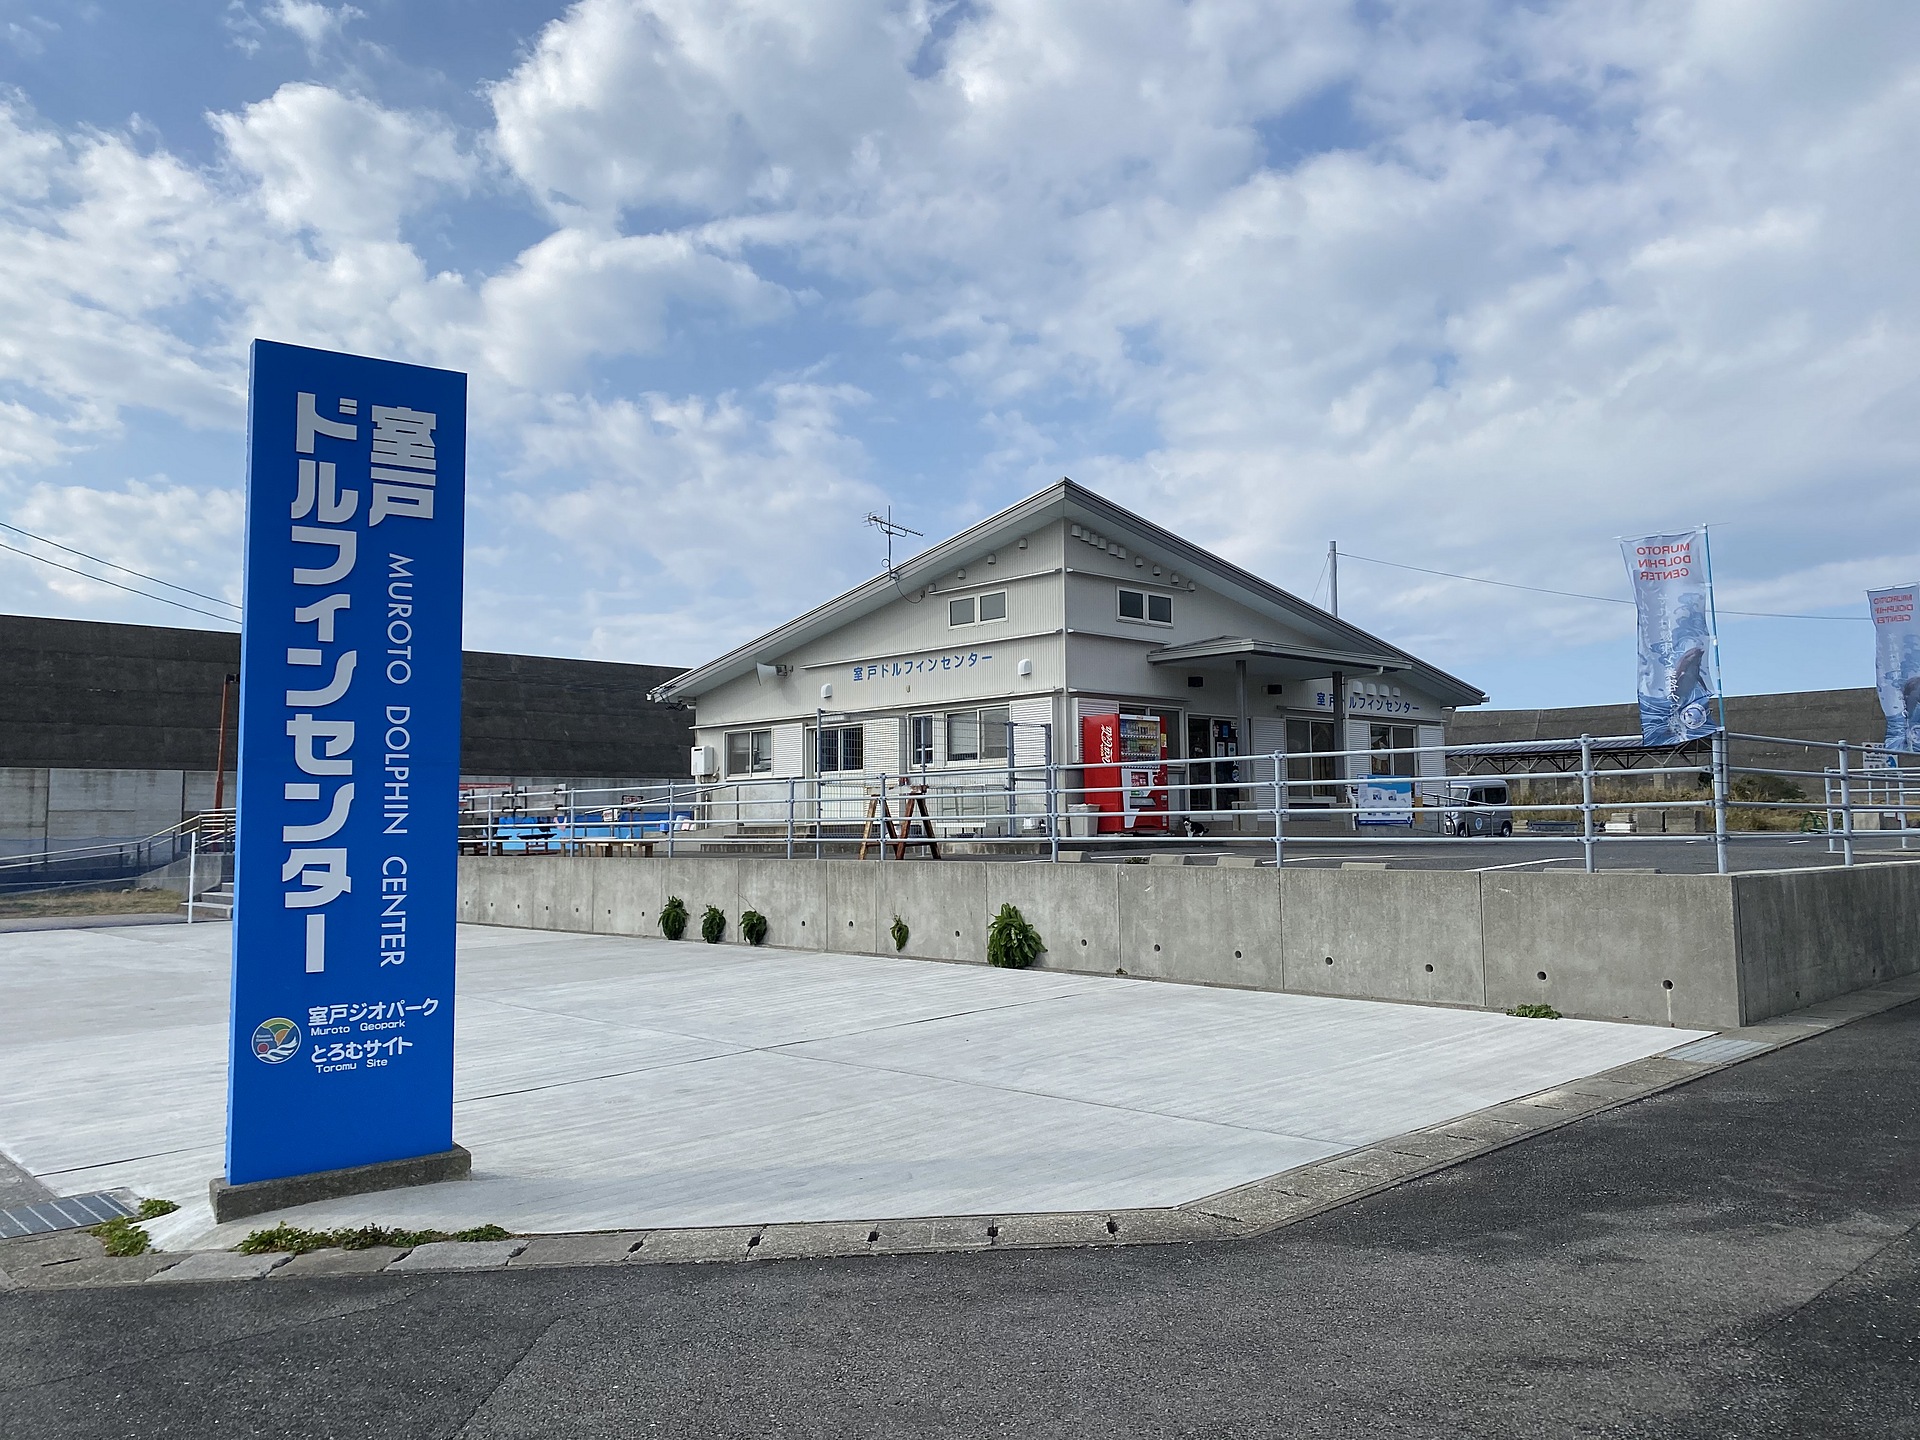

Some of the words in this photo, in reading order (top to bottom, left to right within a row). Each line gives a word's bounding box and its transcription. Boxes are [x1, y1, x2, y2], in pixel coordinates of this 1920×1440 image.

[368, 404, 437, 527] 室戸
[386, 552, 415, 685] MUROTO
[282, 391, 359, 974] ドルフィンセンター
[1316, 692, 1420, 714] 室戸ルフィンセンター
[382, 705, 411, 835] DOLPHIN
[380, 856, 408, 968] CENTER
[308, 997, 439, 1026] 室戸ジオパーク
[310, 1026, 350, 1037] Muroto
[360, 1019, 406, 1032] Geopark
[310, 1036, 413, 1064] とろむサイト
[315, 1061, 357, 1074] Toromu
[366, 1058, 388, 1068] Site
